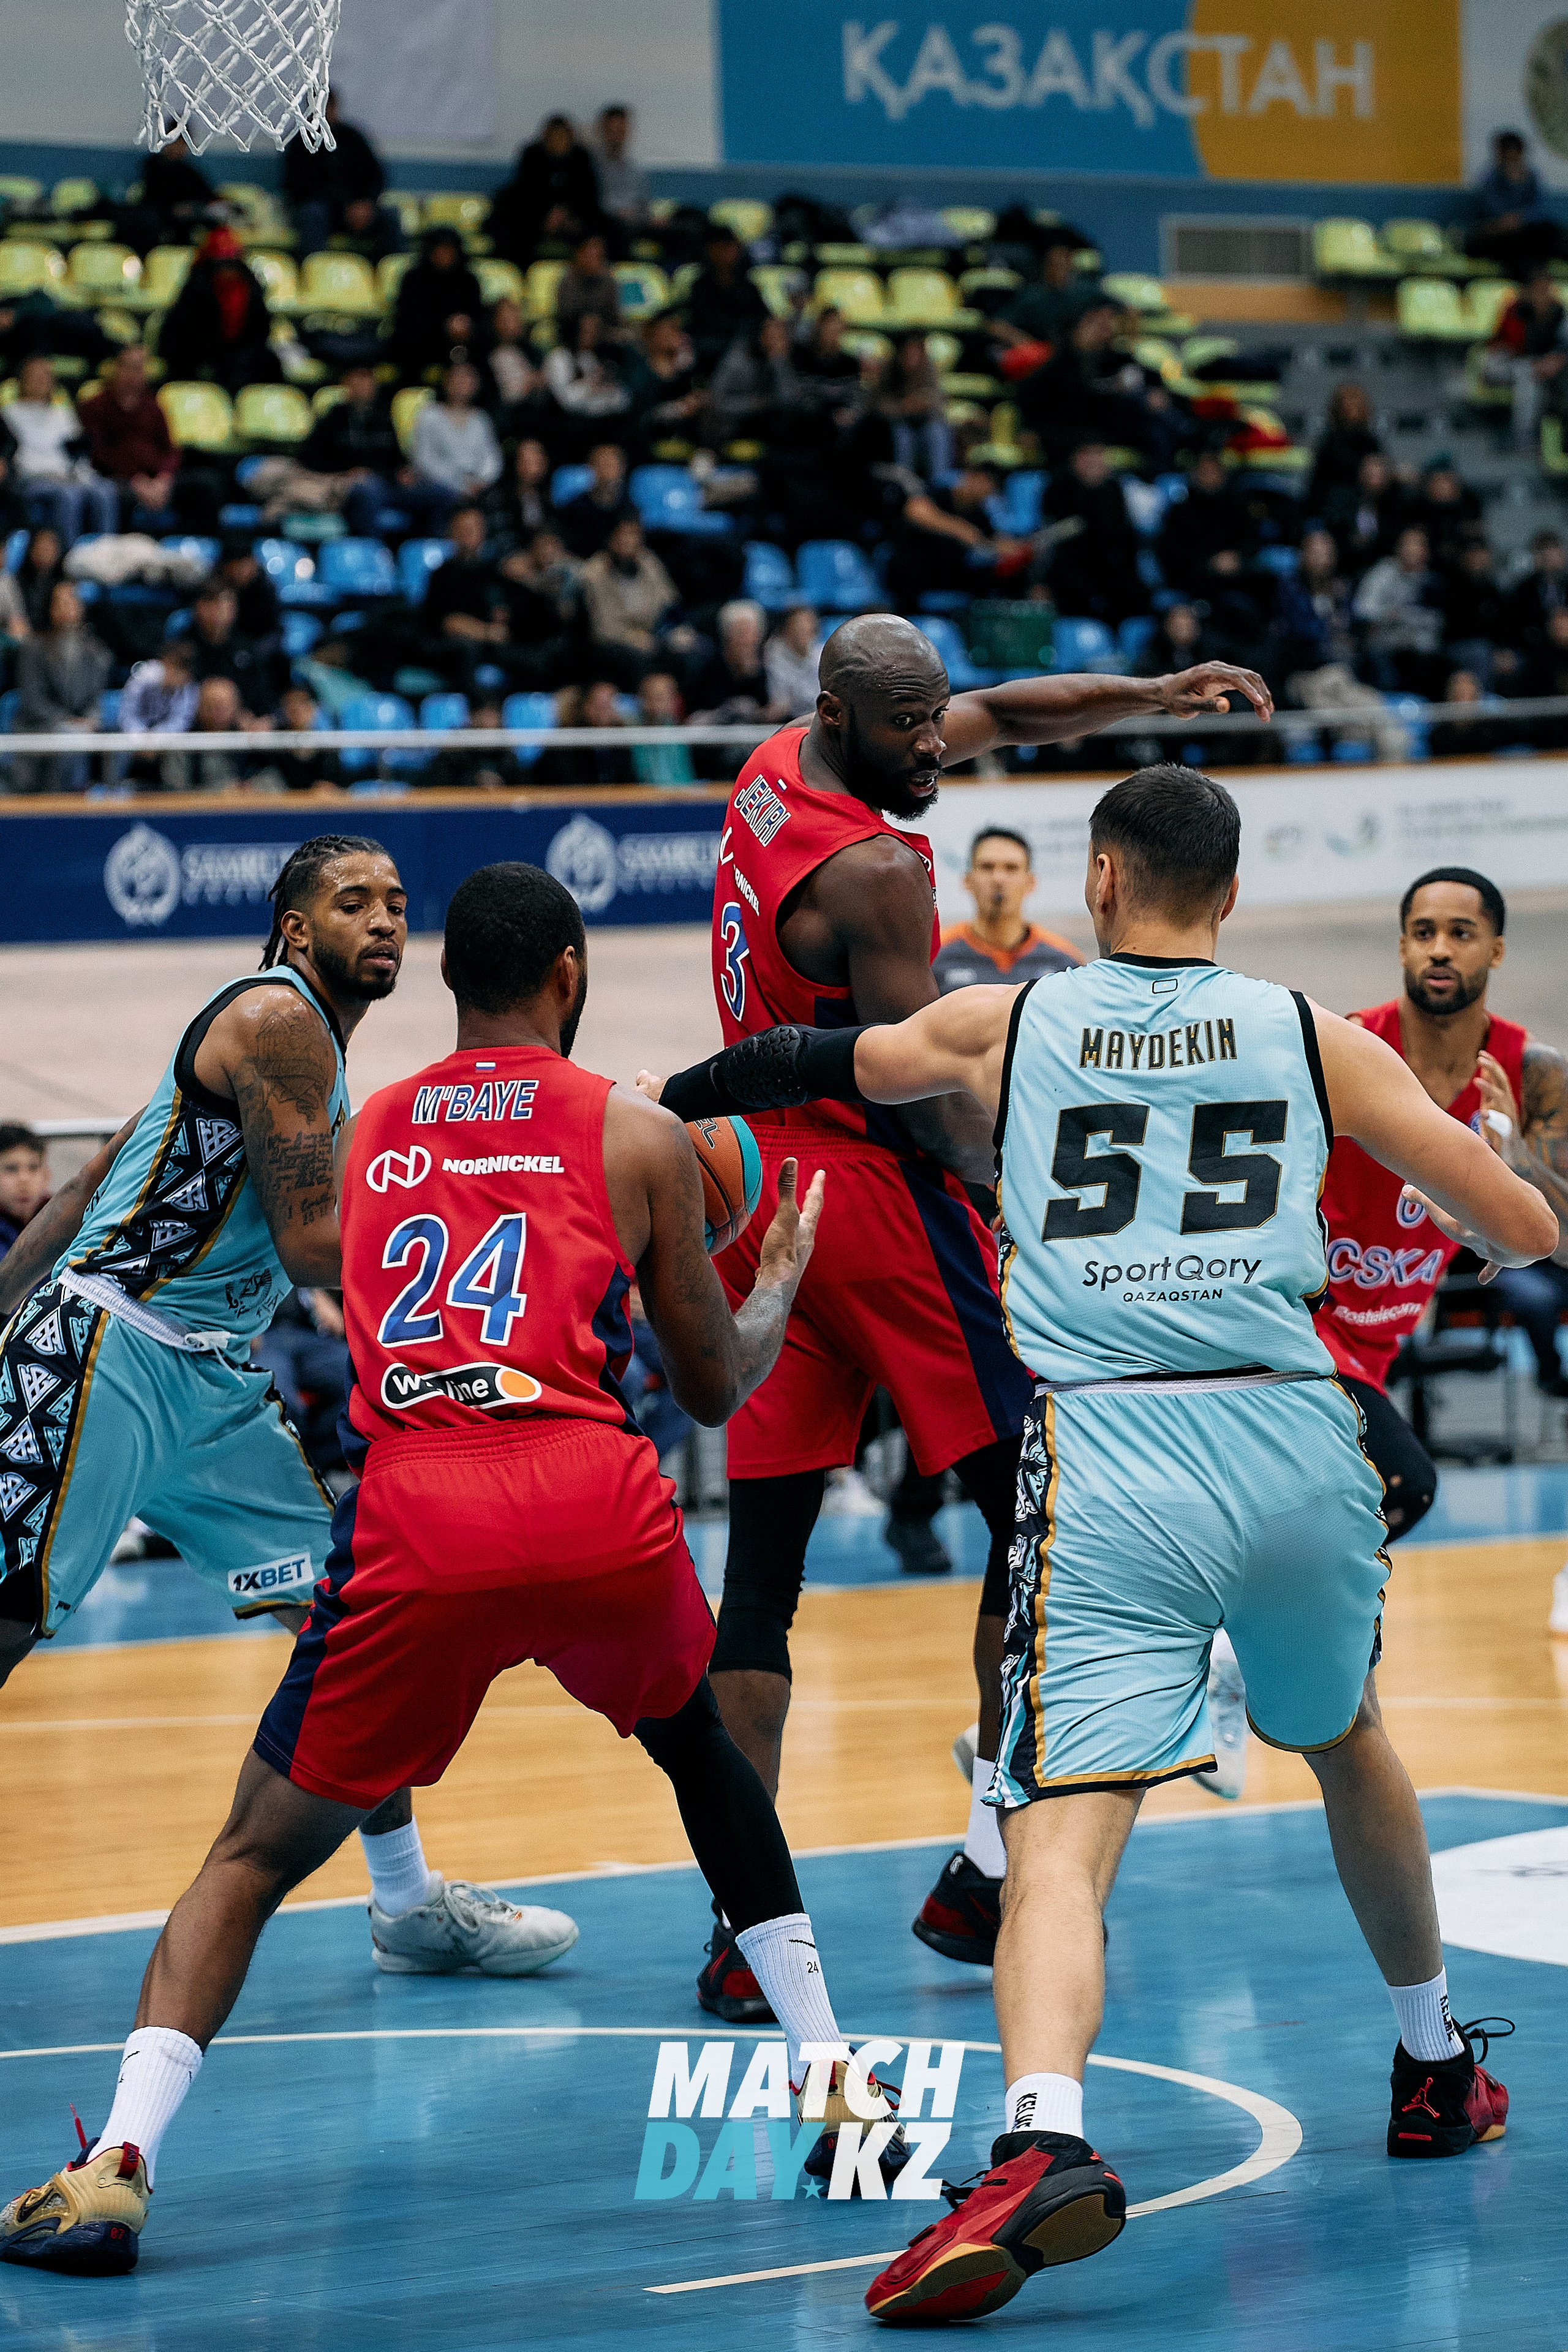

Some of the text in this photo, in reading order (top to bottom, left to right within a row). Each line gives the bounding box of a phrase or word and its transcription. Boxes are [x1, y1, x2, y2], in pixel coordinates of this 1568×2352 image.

[842, 20, 1374, 129] ҚАЗАҚСТАН
[734, 774, 791, 847] JEKIRI
[720, 902, 750, 1022] 3
[1079, 1018, 1237, 1070] MAYDEKIN
[412, 1080, 539, 1124] M'BAYE
[442, 1155, 564, 1175] NORNICKEL
[1042, 1099, 1289, 1242] 55
[377, 1212, 527, 1348] 24
[1326, 1237, 1444, 1289] CSKA
[1123, 1288, 1223, 1302] QAZAQSTAN
[392, 1374, 489, 1401] Wline
[233, 1558, 305, 1591] 1XBET
[807, 1961, 819, 1973] 24
